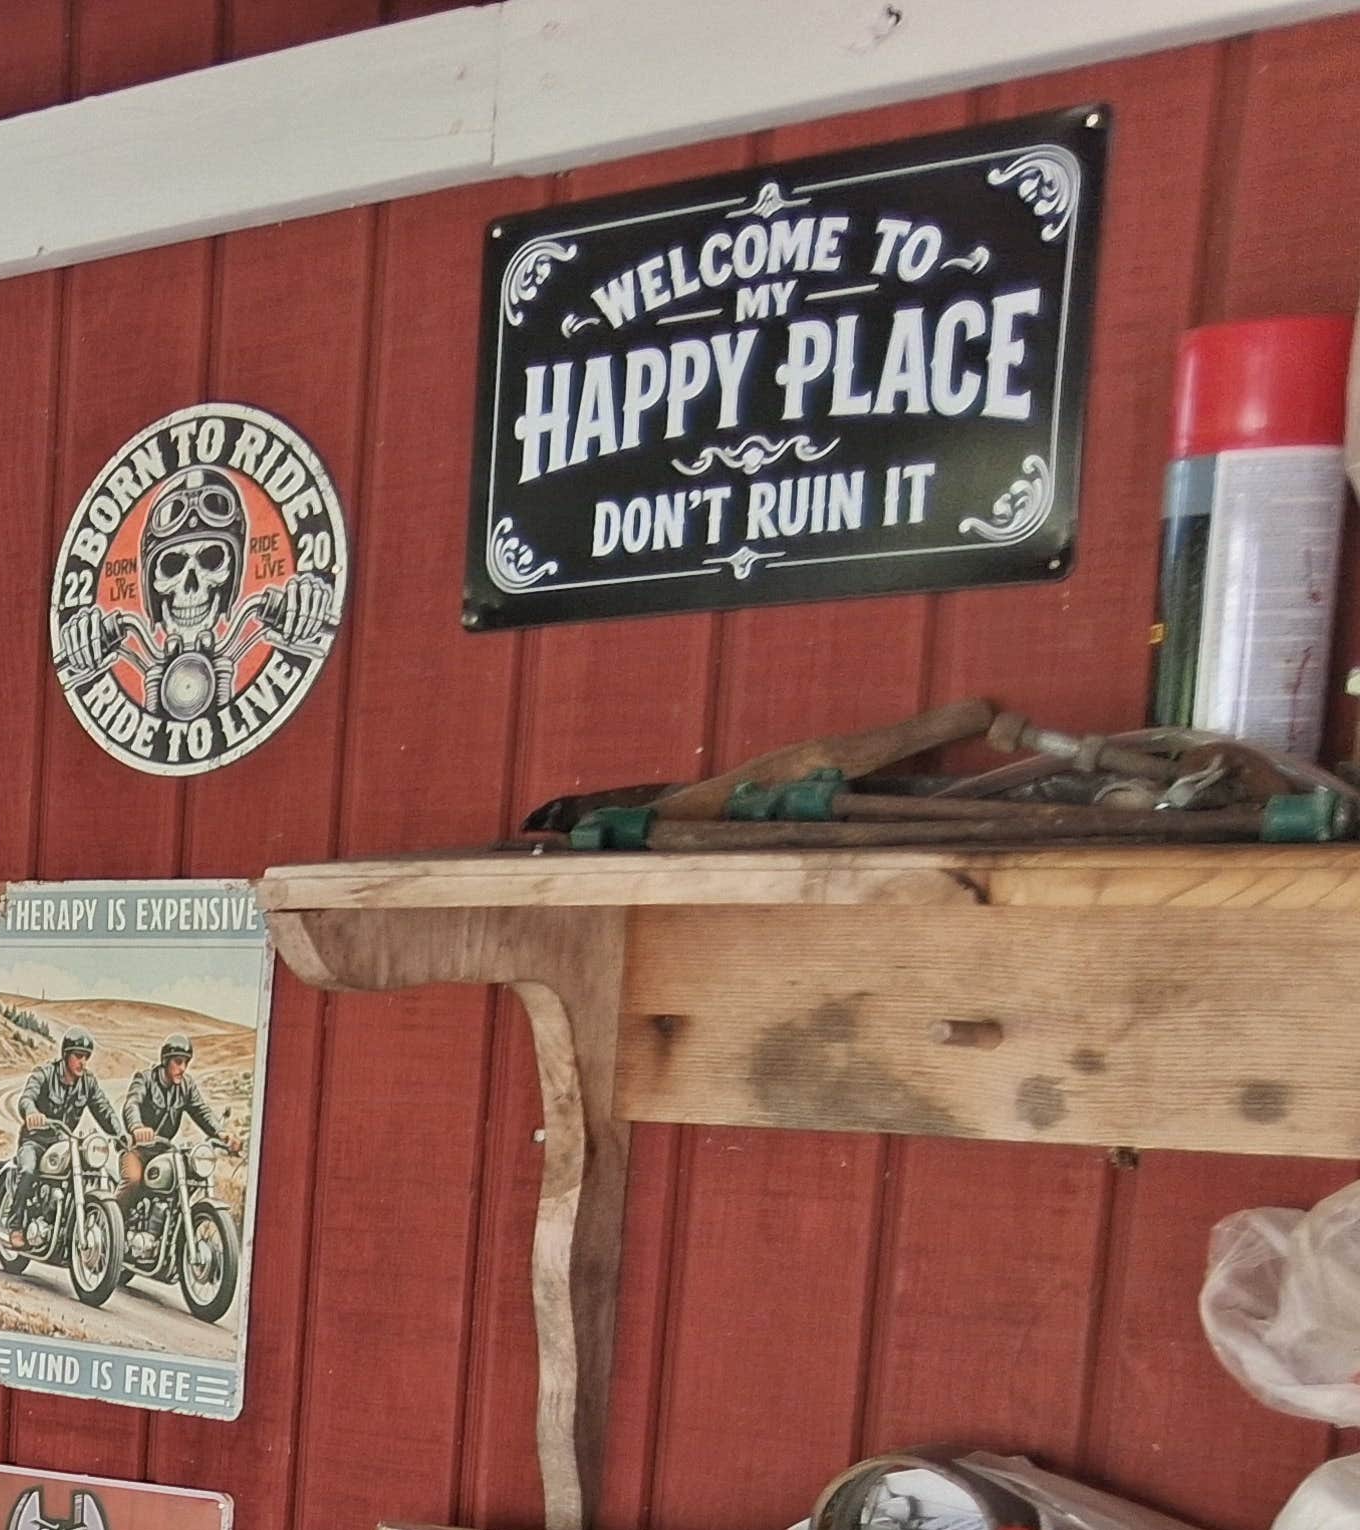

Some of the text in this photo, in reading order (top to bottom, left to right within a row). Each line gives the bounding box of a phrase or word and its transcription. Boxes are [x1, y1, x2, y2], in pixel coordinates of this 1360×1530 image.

[590, 216, 943, 330] WELCOME TO
[735, 279, 798, 323] MY
[514, 288, 1042, 485] HAPPY PLACE
[71, 419, 323, 567] BORN TO RIDE
[591, 462, 937, 558] DON'T RUIN IT
[250, 533, 279, 554] RIDE
[297, 531, 329, 571] 20
[64, 570, 94, 607] 22
[105, 557, 137, 578] BORN
[255, 560, 285, 580] LIVE
[110, 582, 137, 602] LIVE
[83, 652, 302, 762] RIDE TO LIVE
[6, 896, 259, 932] THERAPY IS EXPENSIVE
[15, 1348, 191, 1402] WIND IS FREE
